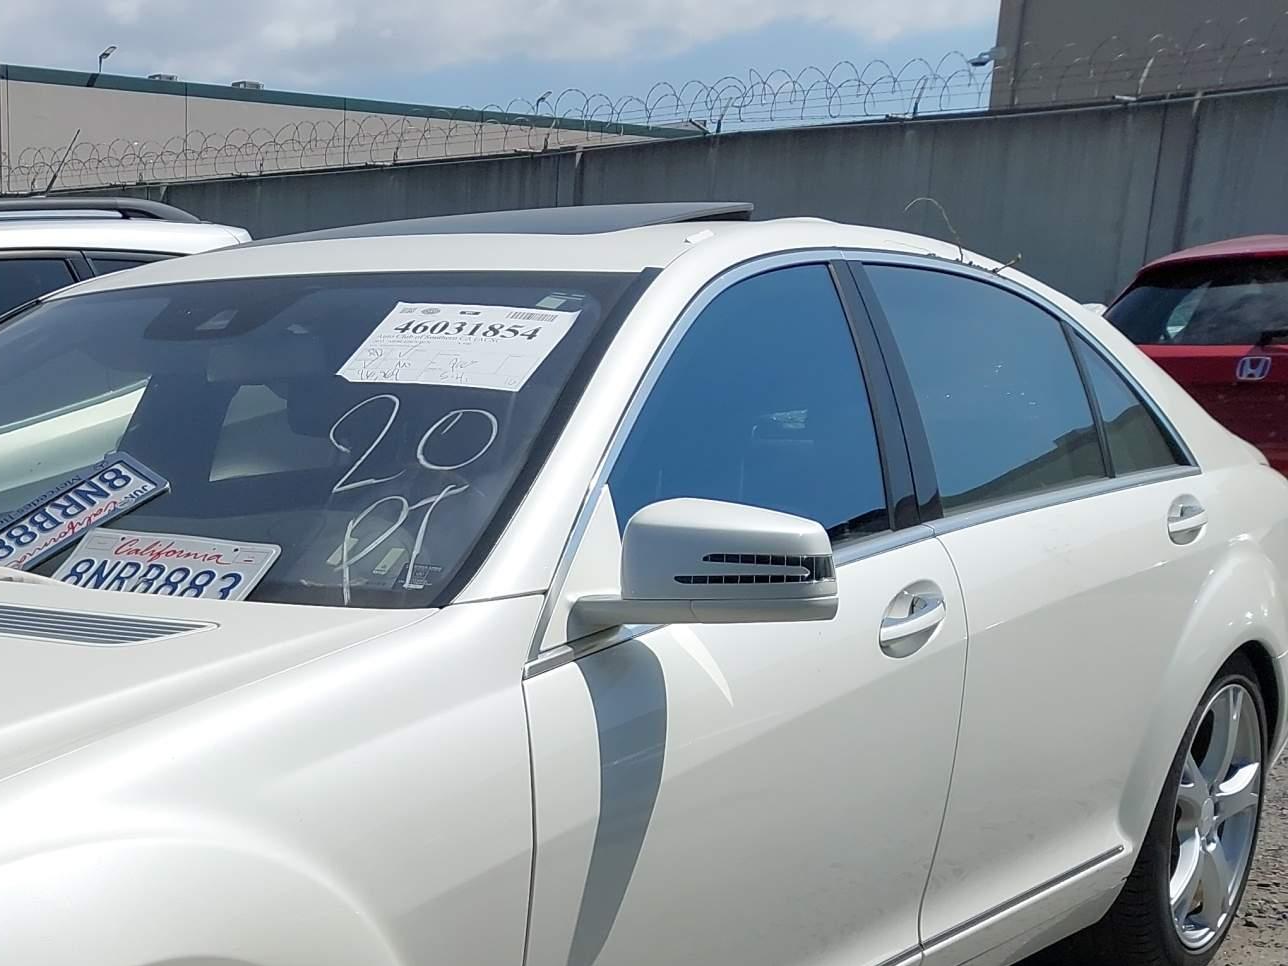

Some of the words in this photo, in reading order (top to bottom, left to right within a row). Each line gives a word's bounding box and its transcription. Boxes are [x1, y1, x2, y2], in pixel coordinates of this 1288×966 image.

[394, 319, 543, 342] 46031854
[330, 394, 498, 493] 20
[114, 537, 232, 566] California
